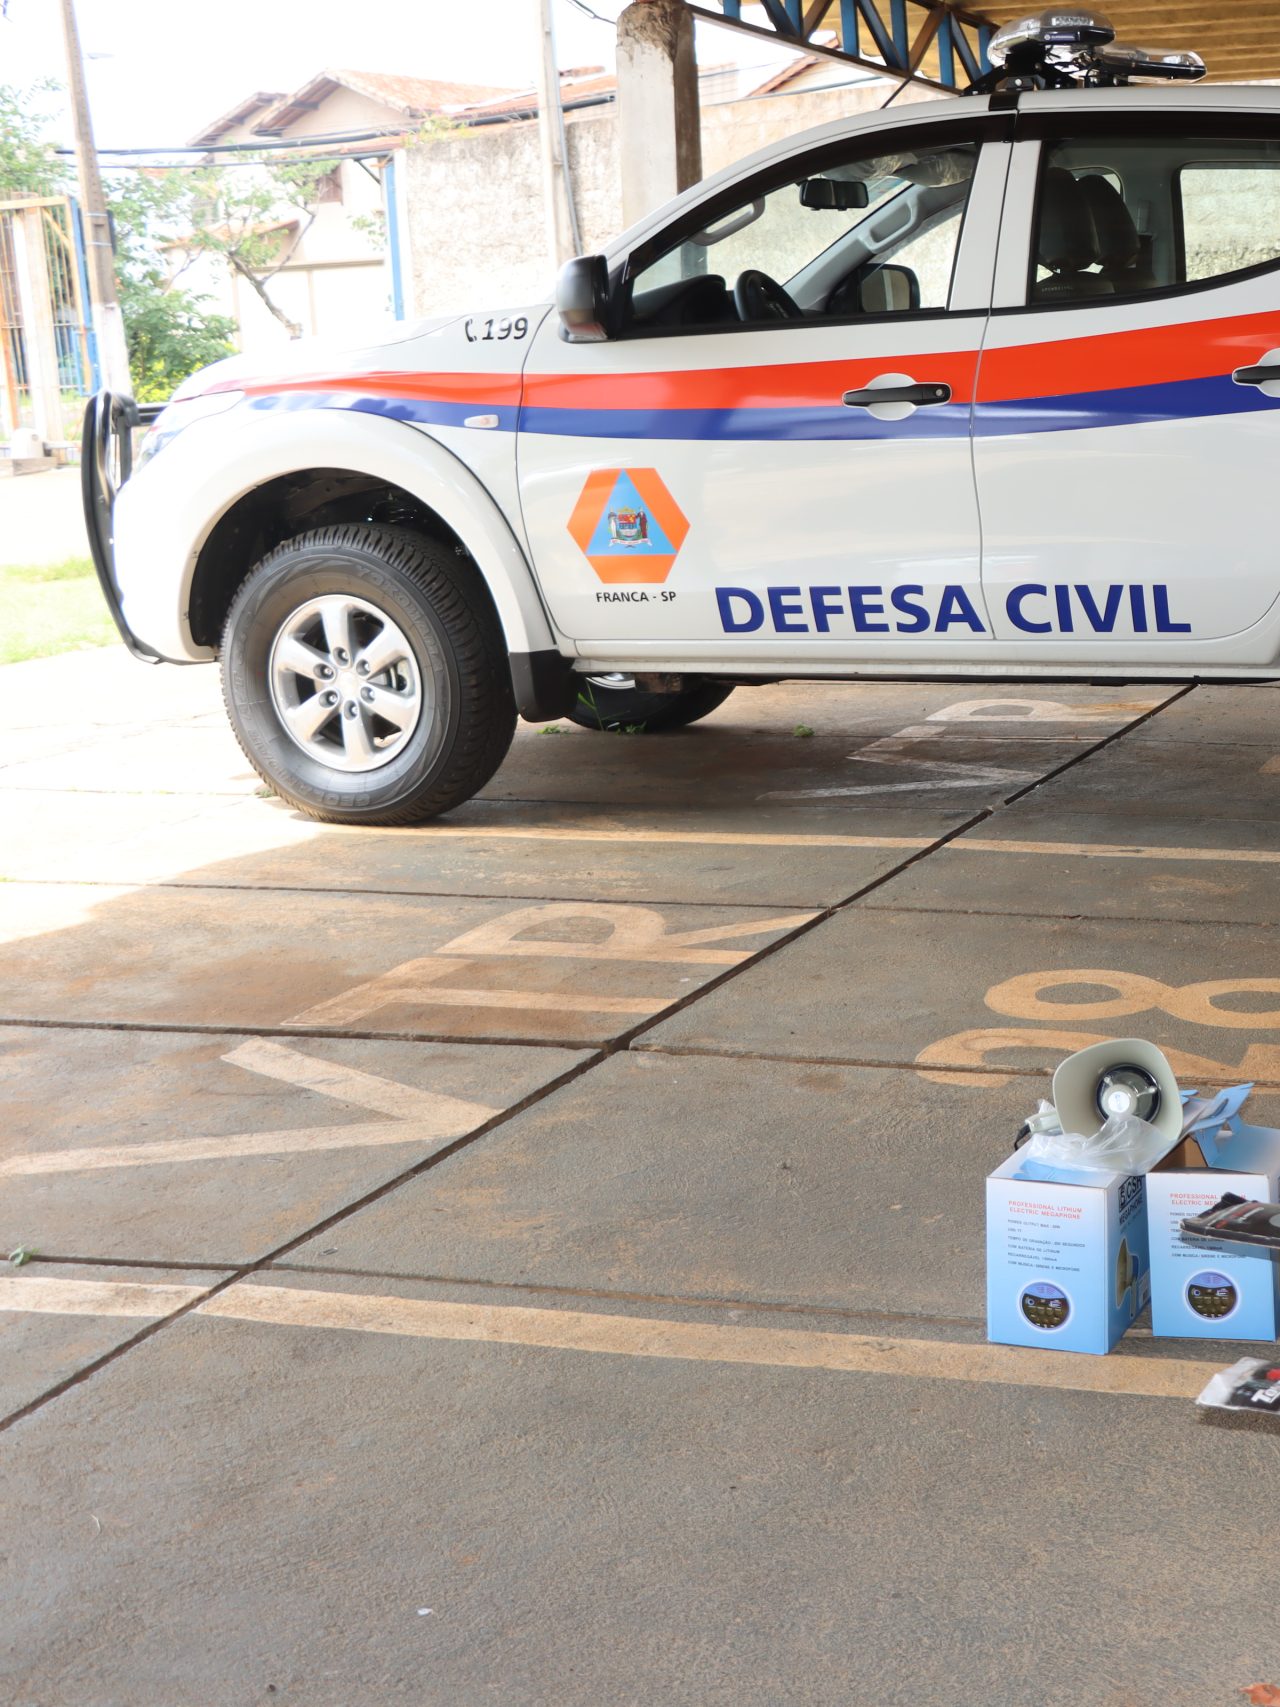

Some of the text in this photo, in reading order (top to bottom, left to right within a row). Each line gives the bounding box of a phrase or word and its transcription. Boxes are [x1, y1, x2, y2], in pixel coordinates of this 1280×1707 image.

[481, 317, 529, 341] 199
[596, 591, 650, 603] FRANCA
[660, 590, 677, 602] SP
[714, 583, 1193, 635] DEFESA CIVIL
[1008, 1200, 1055, 1211] PROFESSIONAL
[1009, 1206, 1081, 1219] ELECTRIC MEGAPHONE
